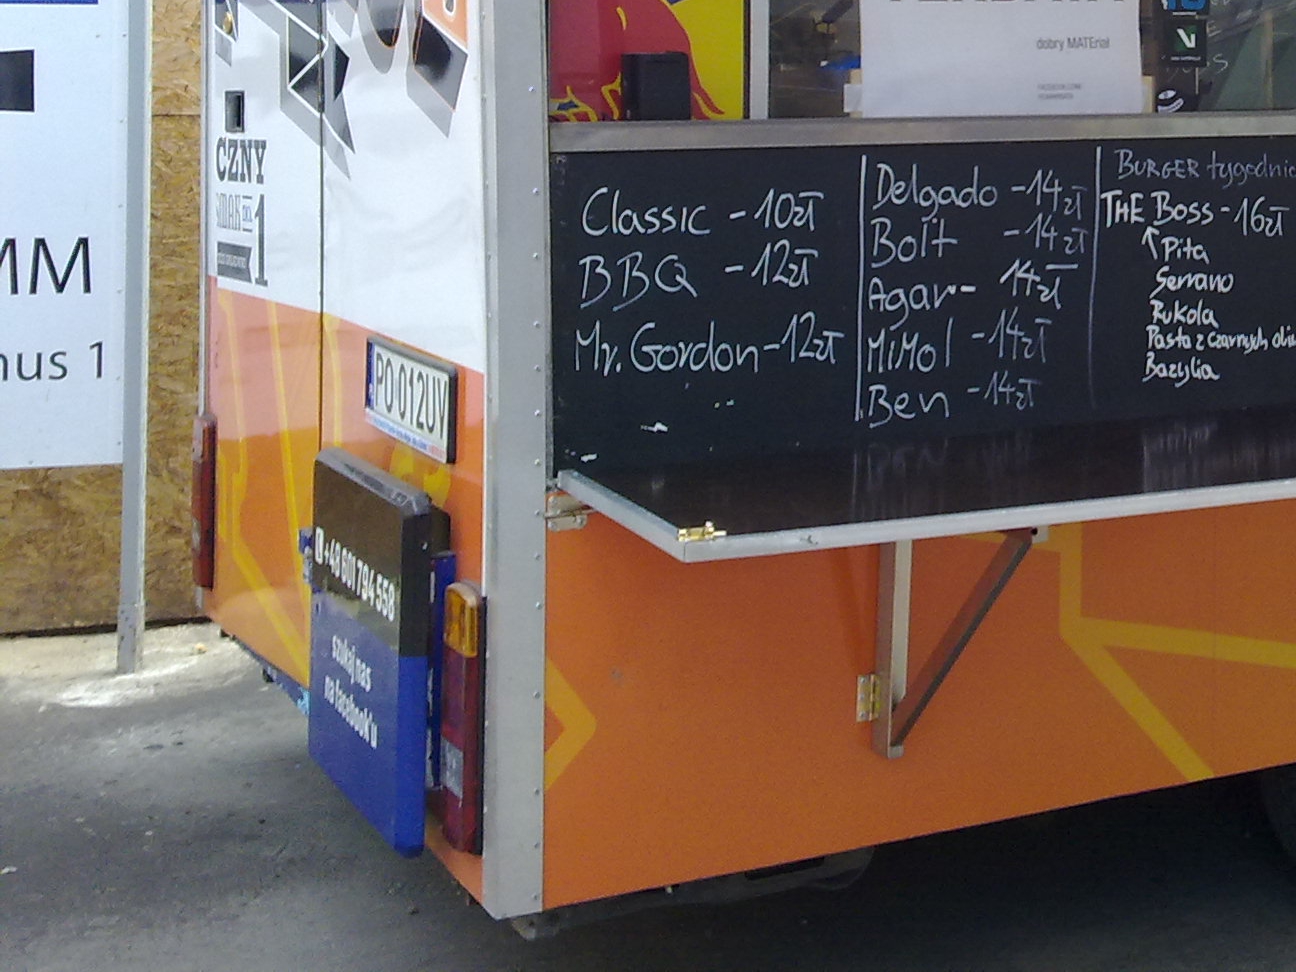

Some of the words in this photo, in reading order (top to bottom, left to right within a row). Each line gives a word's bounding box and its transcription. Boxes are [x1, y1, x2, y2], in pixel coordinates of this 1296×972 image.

[216, 136, 267, 184] CZNY
[582, 186, 711, 237] Classic
[872, 162, 999, 222] Delgado
[1100, 190, 1145, 224] THE
[871, 218, 959, 268] Bolt
[1161, 234, 1211, 265] Pita
[579, 250, 698, 311] BBQ
[1150, 299, 1220, 328] Rukola
[89, 341, 103, 379] 1
[575, 327, 622, 377] Mr.
[630, 320, 759, 374] Gordon
[1146, 324, 1191, 350] Pasta
[1206, 326, 1270, 354] czarnych
[375, 351, 394, 414] PO
[1143, 356, 1221, 389] Bazylia
[869, 383, 950, 428] Ben
